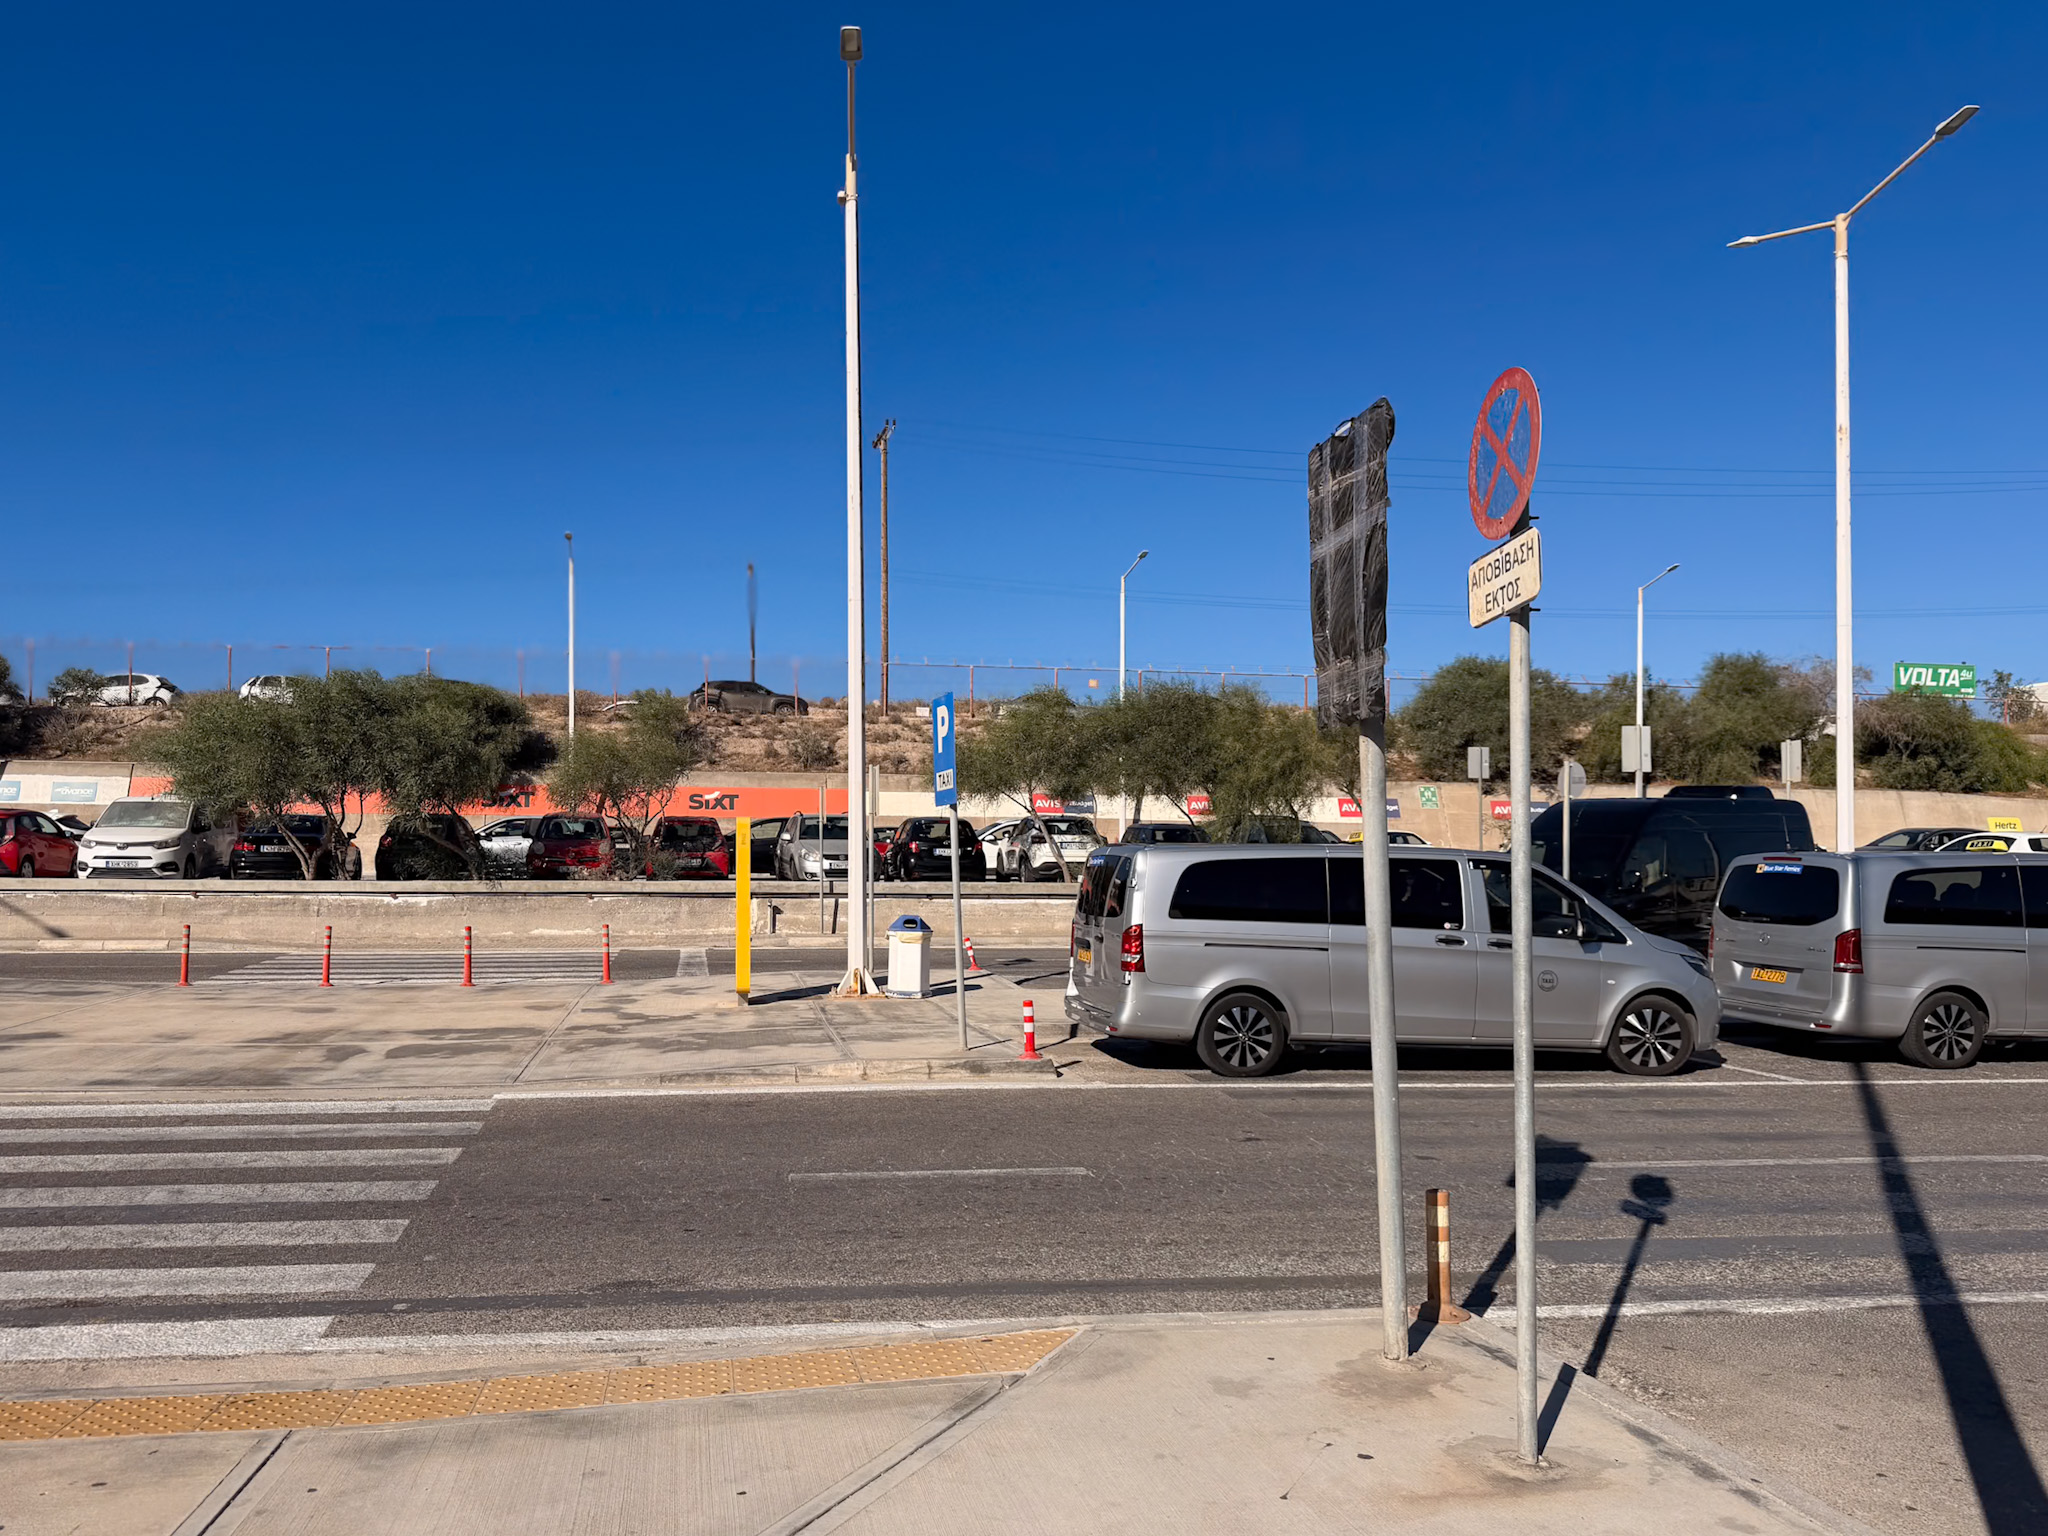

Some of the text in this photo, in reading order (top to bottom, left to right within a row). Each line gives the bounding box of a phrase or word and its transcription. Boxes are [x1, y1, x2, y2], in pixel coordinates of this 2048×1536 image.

[1471, 538, 1534, 592] ΑΠΟΒΙΒΑΣΗ
[1485, 577, 1521, 613] ΕΚΤΟΣ
[1899, 667, 1960, 687] VOLTA
[937, 705, 949, 753] P
[938, 772, 952, 788] TAXI
[689, 791, 739, 810] SIXT
[1035, 799, 1061, 808] AVIS
